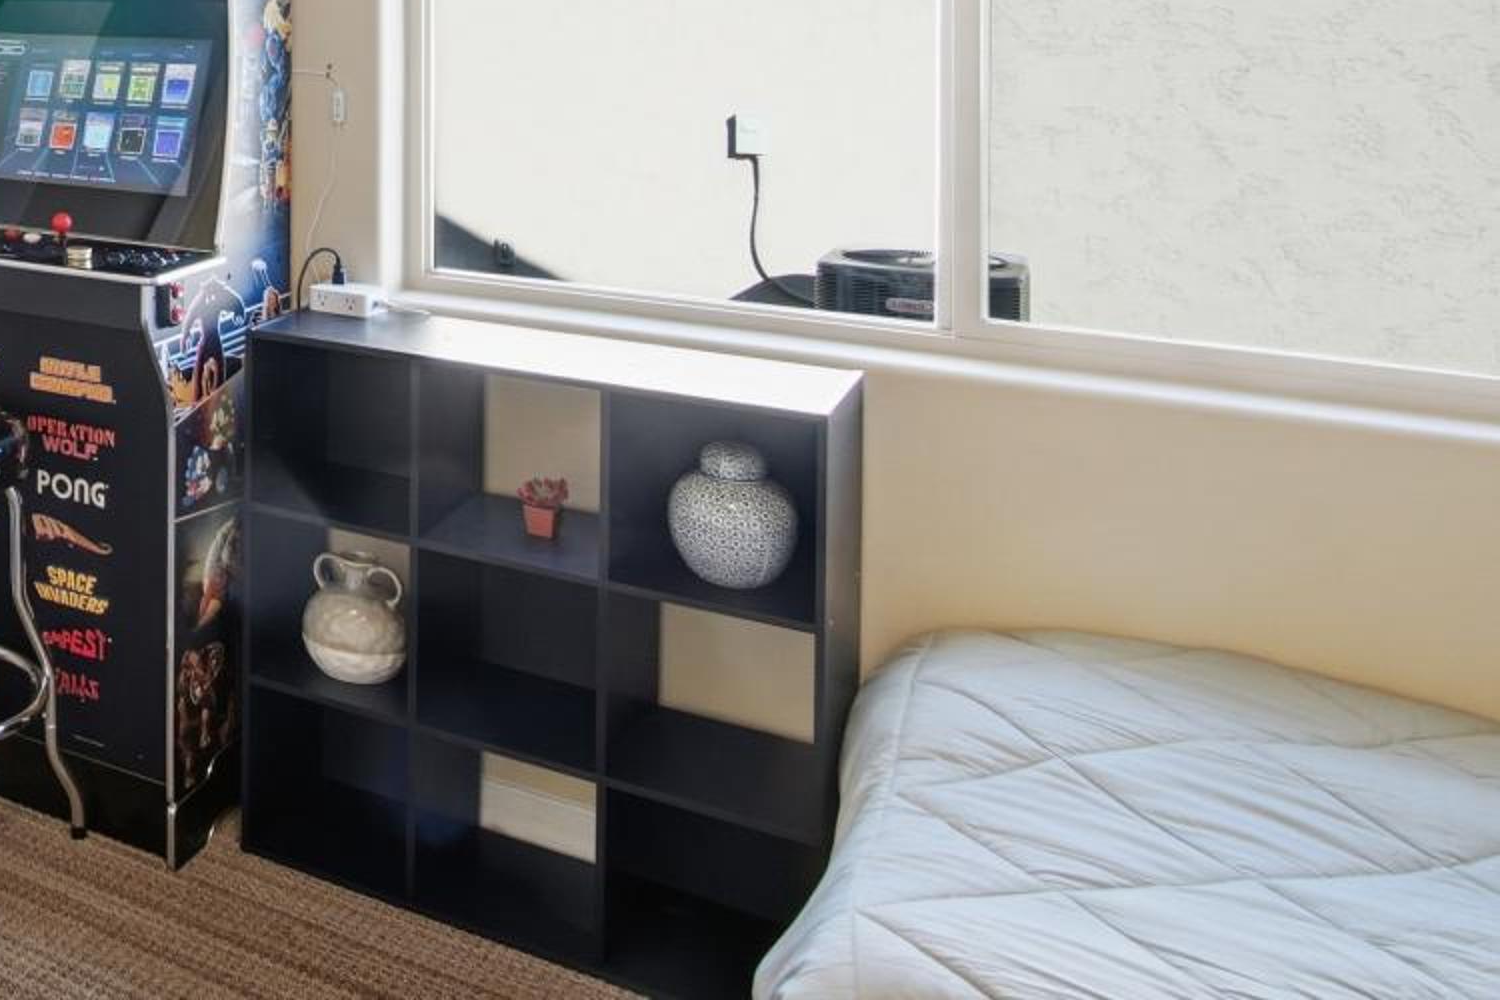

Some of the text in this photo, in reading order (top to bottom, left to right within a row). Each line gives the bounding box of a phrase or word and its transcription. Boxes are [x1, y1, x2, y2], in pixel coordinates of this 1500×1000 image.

[27, 414, 115, 448] OPERATION
[42, 434, 99, 460] WOLF
[37, 469, 105, 509] PONG
[46, 565, 98, 595] SPACE
[34, 581, 109, 615] INVADERS
